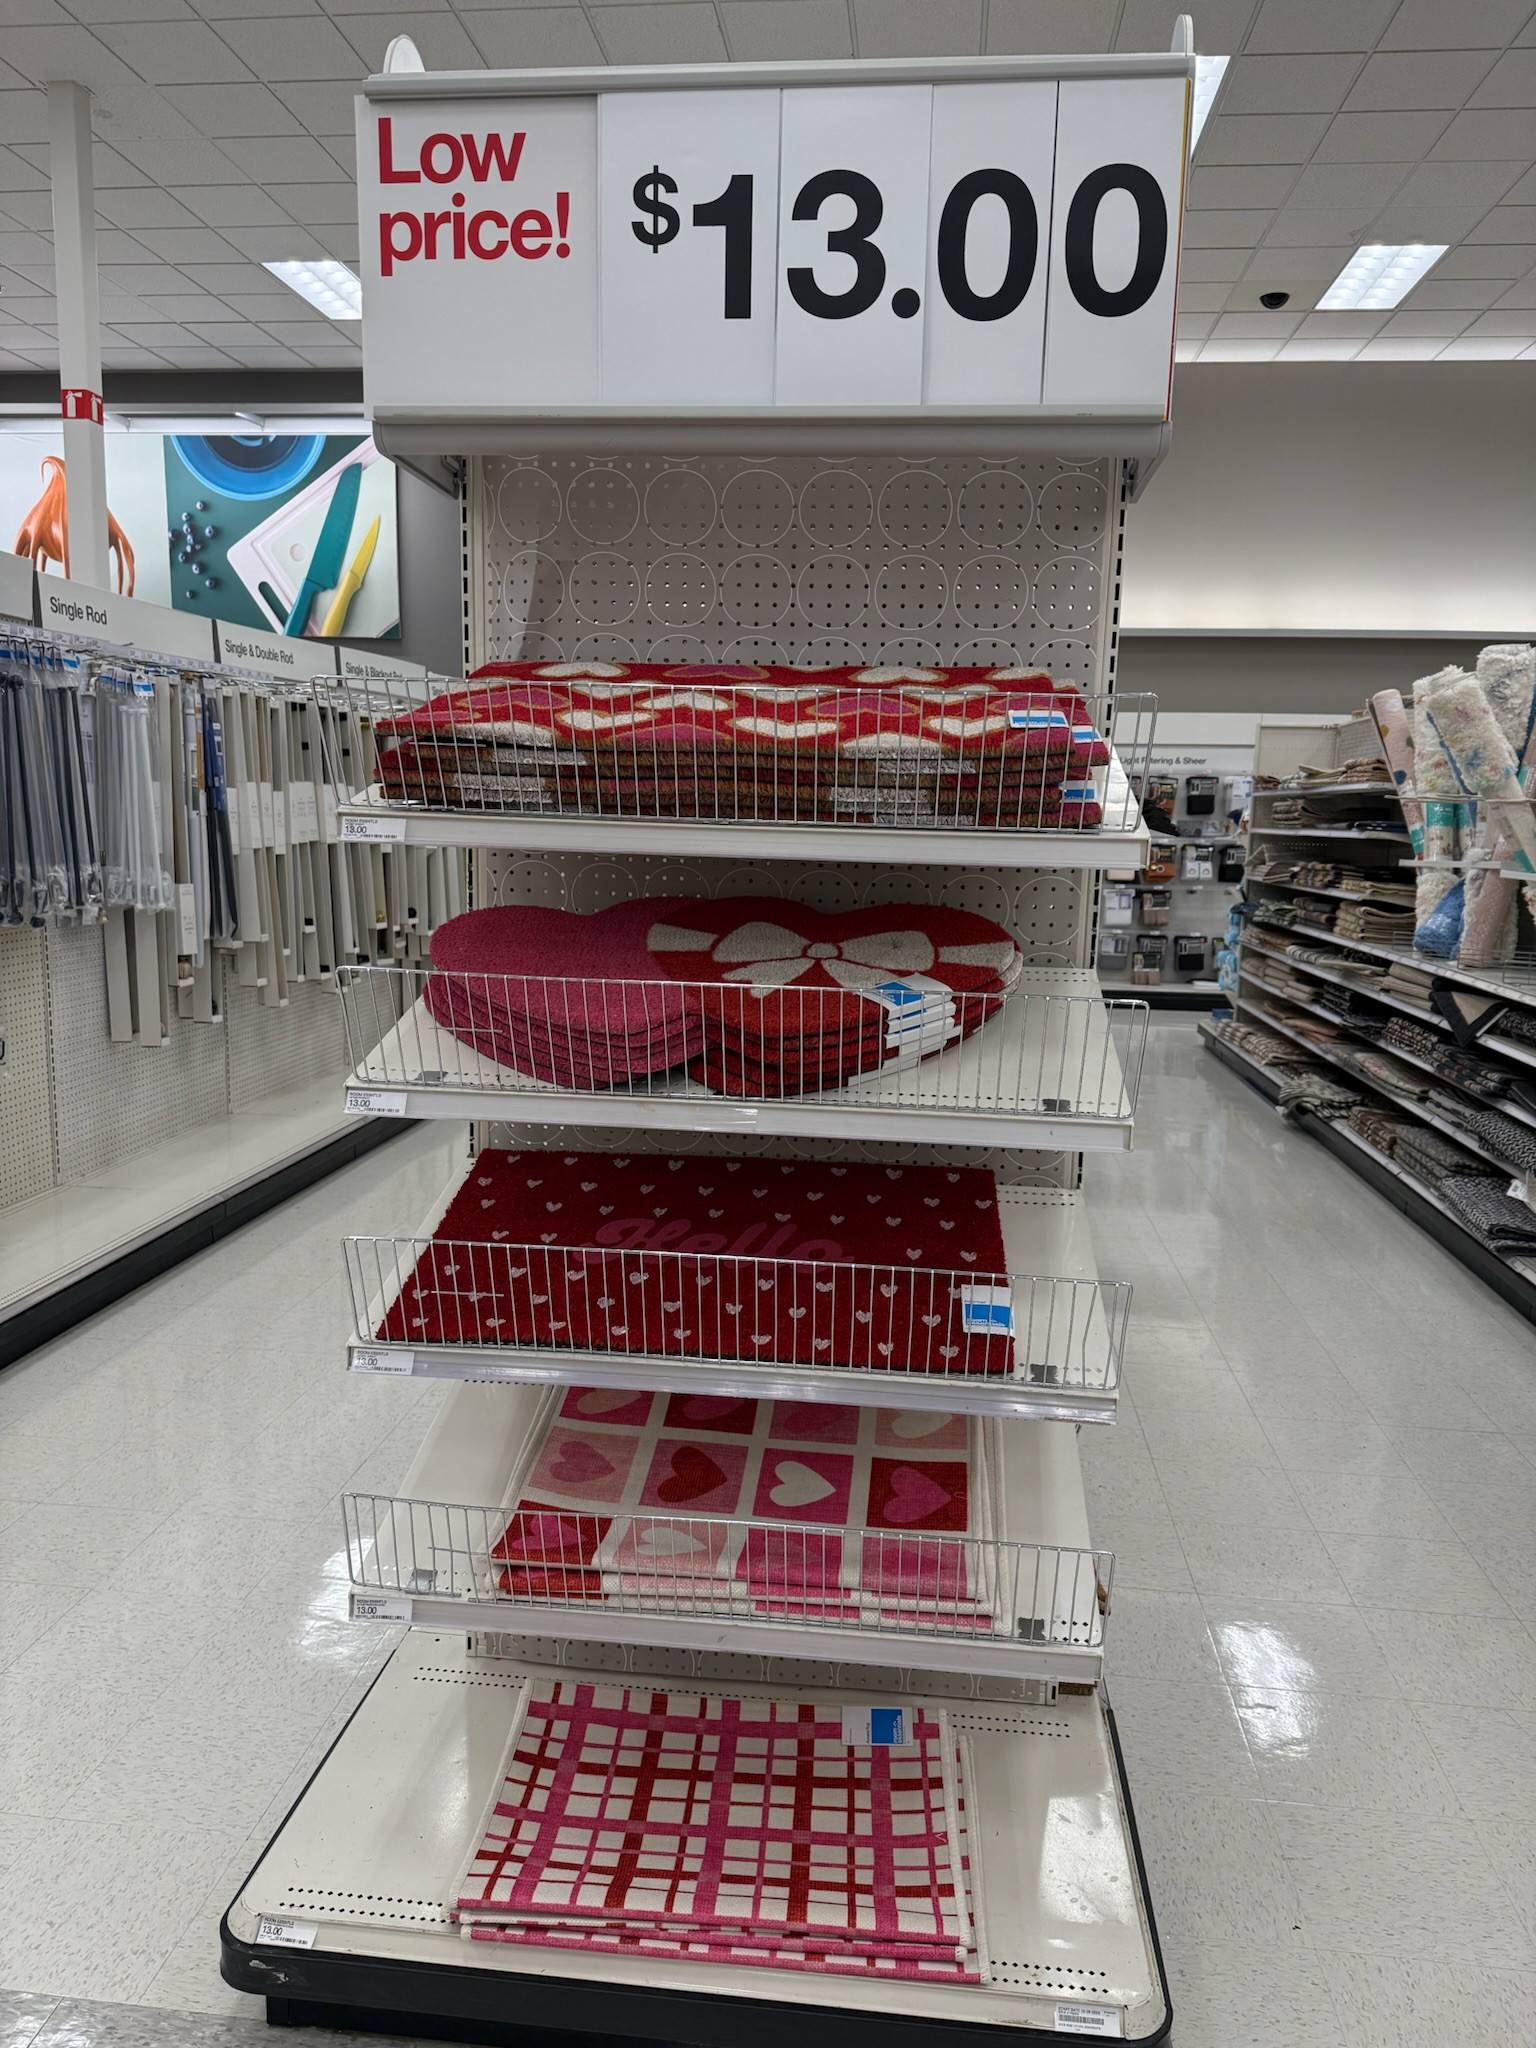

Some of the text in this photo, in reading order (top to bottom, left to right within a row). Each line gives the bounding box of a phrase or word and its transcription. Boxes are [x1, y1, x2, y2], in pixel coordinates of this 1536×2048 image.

[378, 117, 527, 184] Low
[379, 191, 571, 277] price!
[631, 163, 1168, 322] $13.00
[50, 596, 107, 625] Single Rod
[225, 639, 295, 664] Single & Double Rod
[345, 661, 364, 677] Single
[1183, 757, 1206, 765] Sheer
[345, 825, 367, 834] 13.00
[349, 1099, 371, 1107] 13.00
[572, 1218, 856, 1273] Hello
[357, 1357, 378, 1366] 13.00
[357, 1606, 377, 1614] 13.00
[263, 1925, 283, 1936] 13.00
